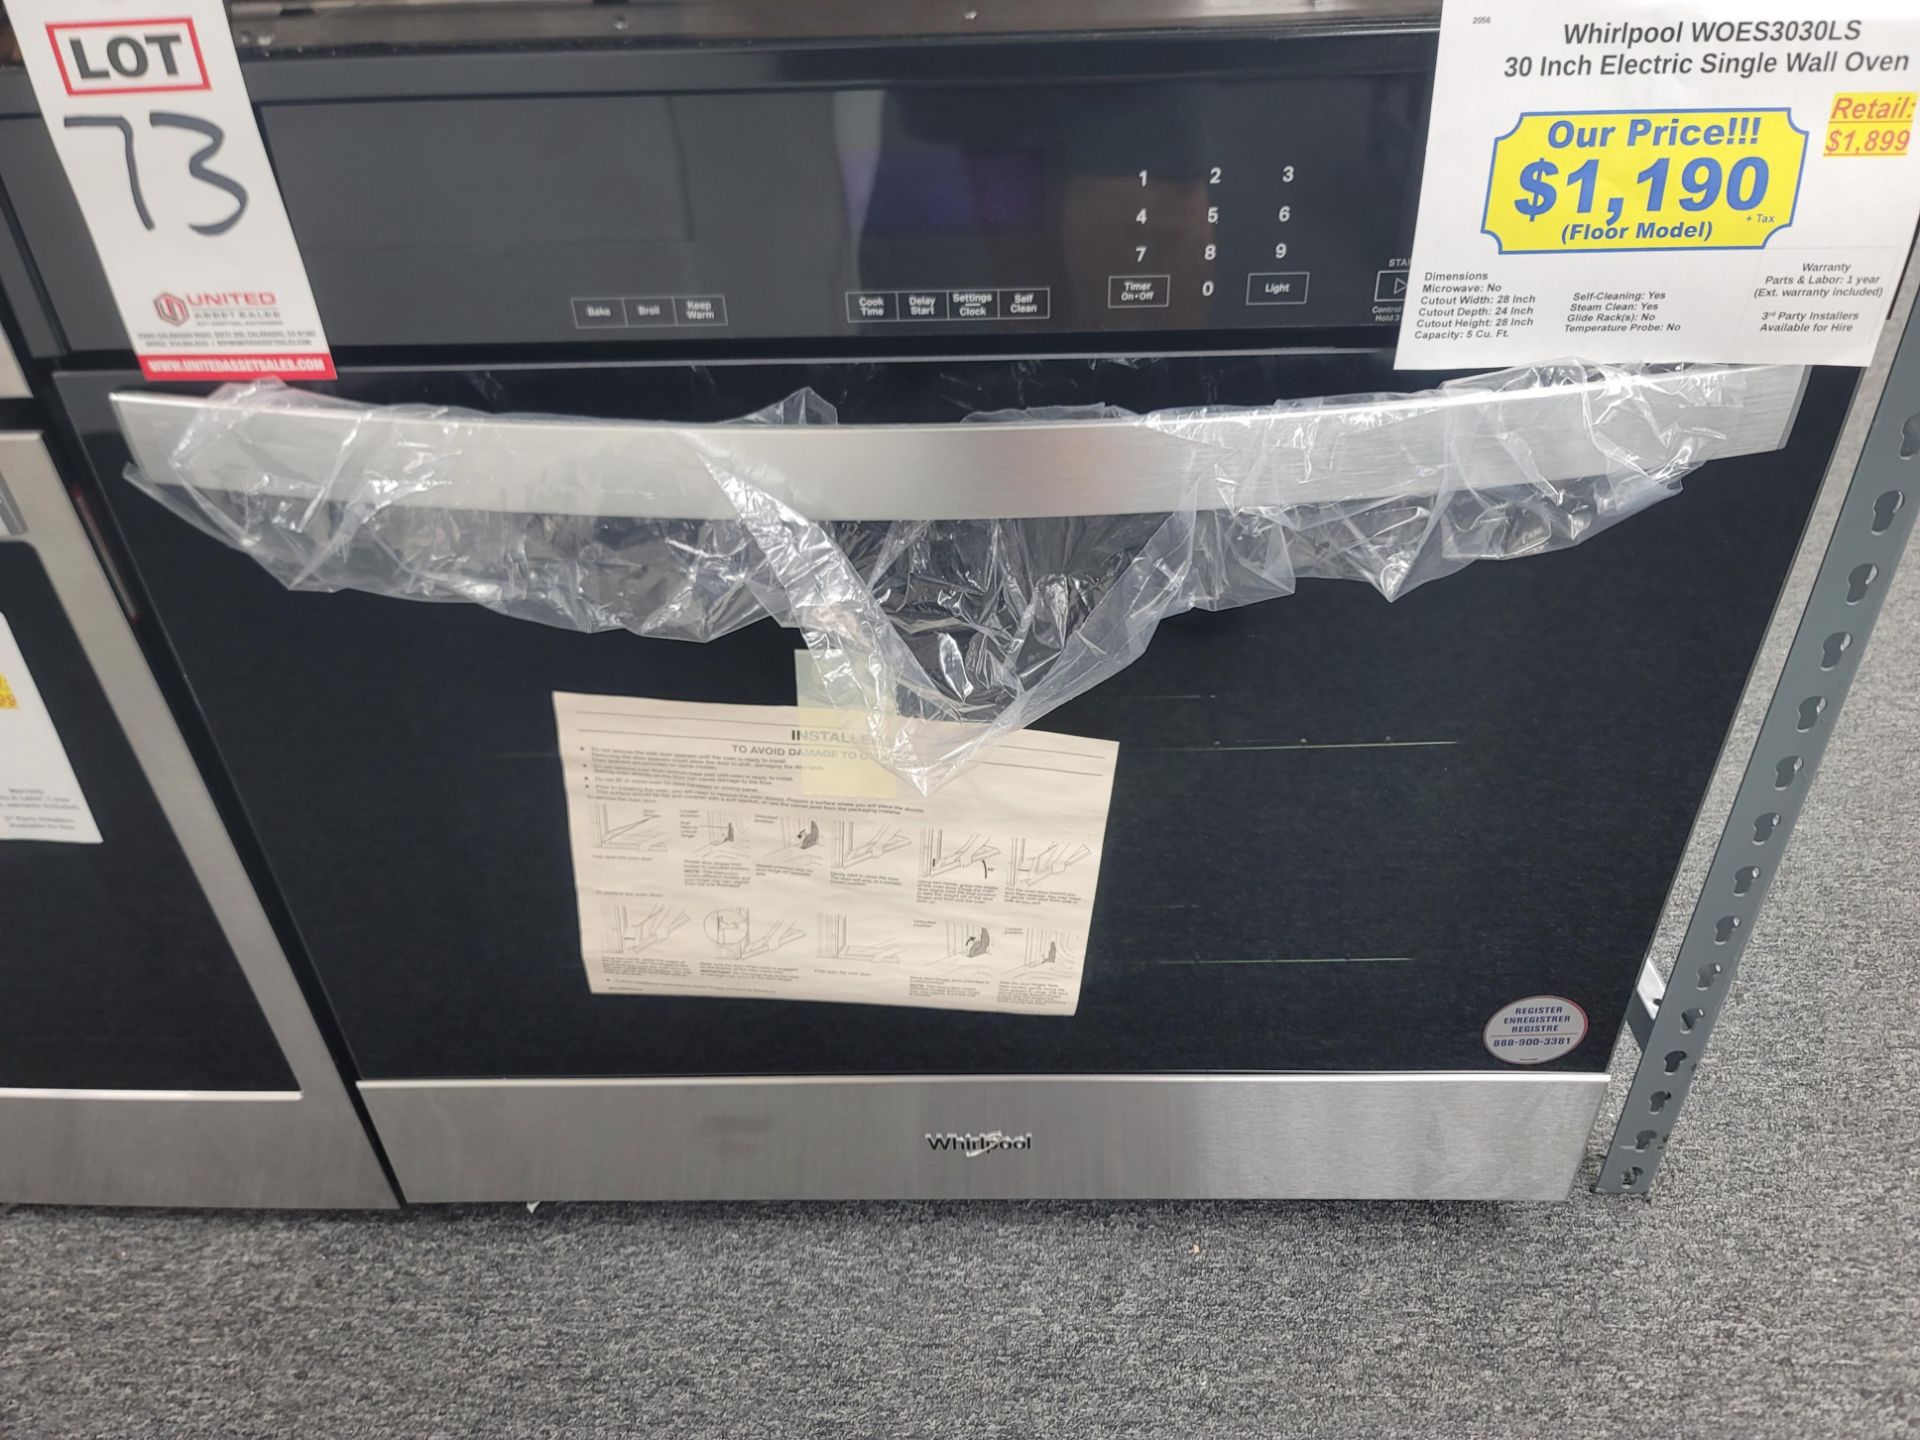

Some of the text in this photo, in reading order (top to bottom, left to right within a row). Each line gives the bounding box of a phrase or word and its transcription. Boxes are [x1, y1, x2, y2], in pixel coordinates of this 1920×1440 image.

[1564, 20, 1862, 49] Whirlpool WOES3030LS
[69, 33, 182, 80] LOT
[1504, 51, 1910, 78] 30 Inch Electric Single Wall Oven
[1831, 97, 1917, 119] Retail:
[1548, 117, 1762, 149] Our Price!!!
[1825, 129, 1911, 155] $1,899
[64, 111, 249, 236] 73
[1138, 165, 1295, 187] 1 2 3
[1514, 156, 1770, 225] $1,190
[1135, 205, 1290, 225] 4 5 6
[1756, 214, 1775, 223] Tax
[1561, 222, 1713, 244] (Floor Model)
[1135, 242, 1287, 262] 7 8 9
[1802, 262, 1851, 274] Warranty
[1424, 272, 1489, 281] Dimensions
[1765, 275, 1880, 286] Parts & Labor: 1 year
[1123, 281, 1152, 291] Timer
[1202, 280, 1214, 297] 0
[1264, 283, 1290, 294] Light
[1422, 283, 1502, 293] Microwave: No
[952, 293, 993, 303] Settings
[1014, 293, 1034, 303] Self
[1573, 291, 1666, 301] Self-Cleaning: Yes
[1753, 287, 1883, 299] (Ext. warranty included)
[185, 292, 278, 307] UNITED
[859, 297, 884, 306] Cook
[909, 296, 936, 306] Delay
[1421, 295, 1536, 305] Cutout Width: 28 Inch
[686, 300, 712, 311] Keep
[860, 306, 884, 316] Time
[911, 306, 935, 315] Start
[1010, 303, 1037, 313] Clean
[1570, 302, 1658, 312] Steam Clean: Yes
[686, 311, 715, 319] Warm
[959, 307, 986, 316] Clock
[1418, 307, 1533, 318] Cutout Depth: 24 Inch
[1778, 311, 1806, 322] Party
[1809, 311, 1859, 320] Installers
[1416, 318, 1533, 329] Cutout Height: 28 Inch
[1567, 313, 1656, 323] Glide Rack(s): No
[1564, 323, 1681, 333] Temperature Probe: No
[1760, 323, 1853, 332] Available for Hire
[1414, 331, 1464, 341] Capacity:
[1466, 330, 1473, 338] 5
[733, 745, 748, 754] TO
[750, 745, 785, 756] AVOID
[1515, 1006, 1563, 1015] REGISTER
[925, 1132, 1032, 1154] Whirlpool
